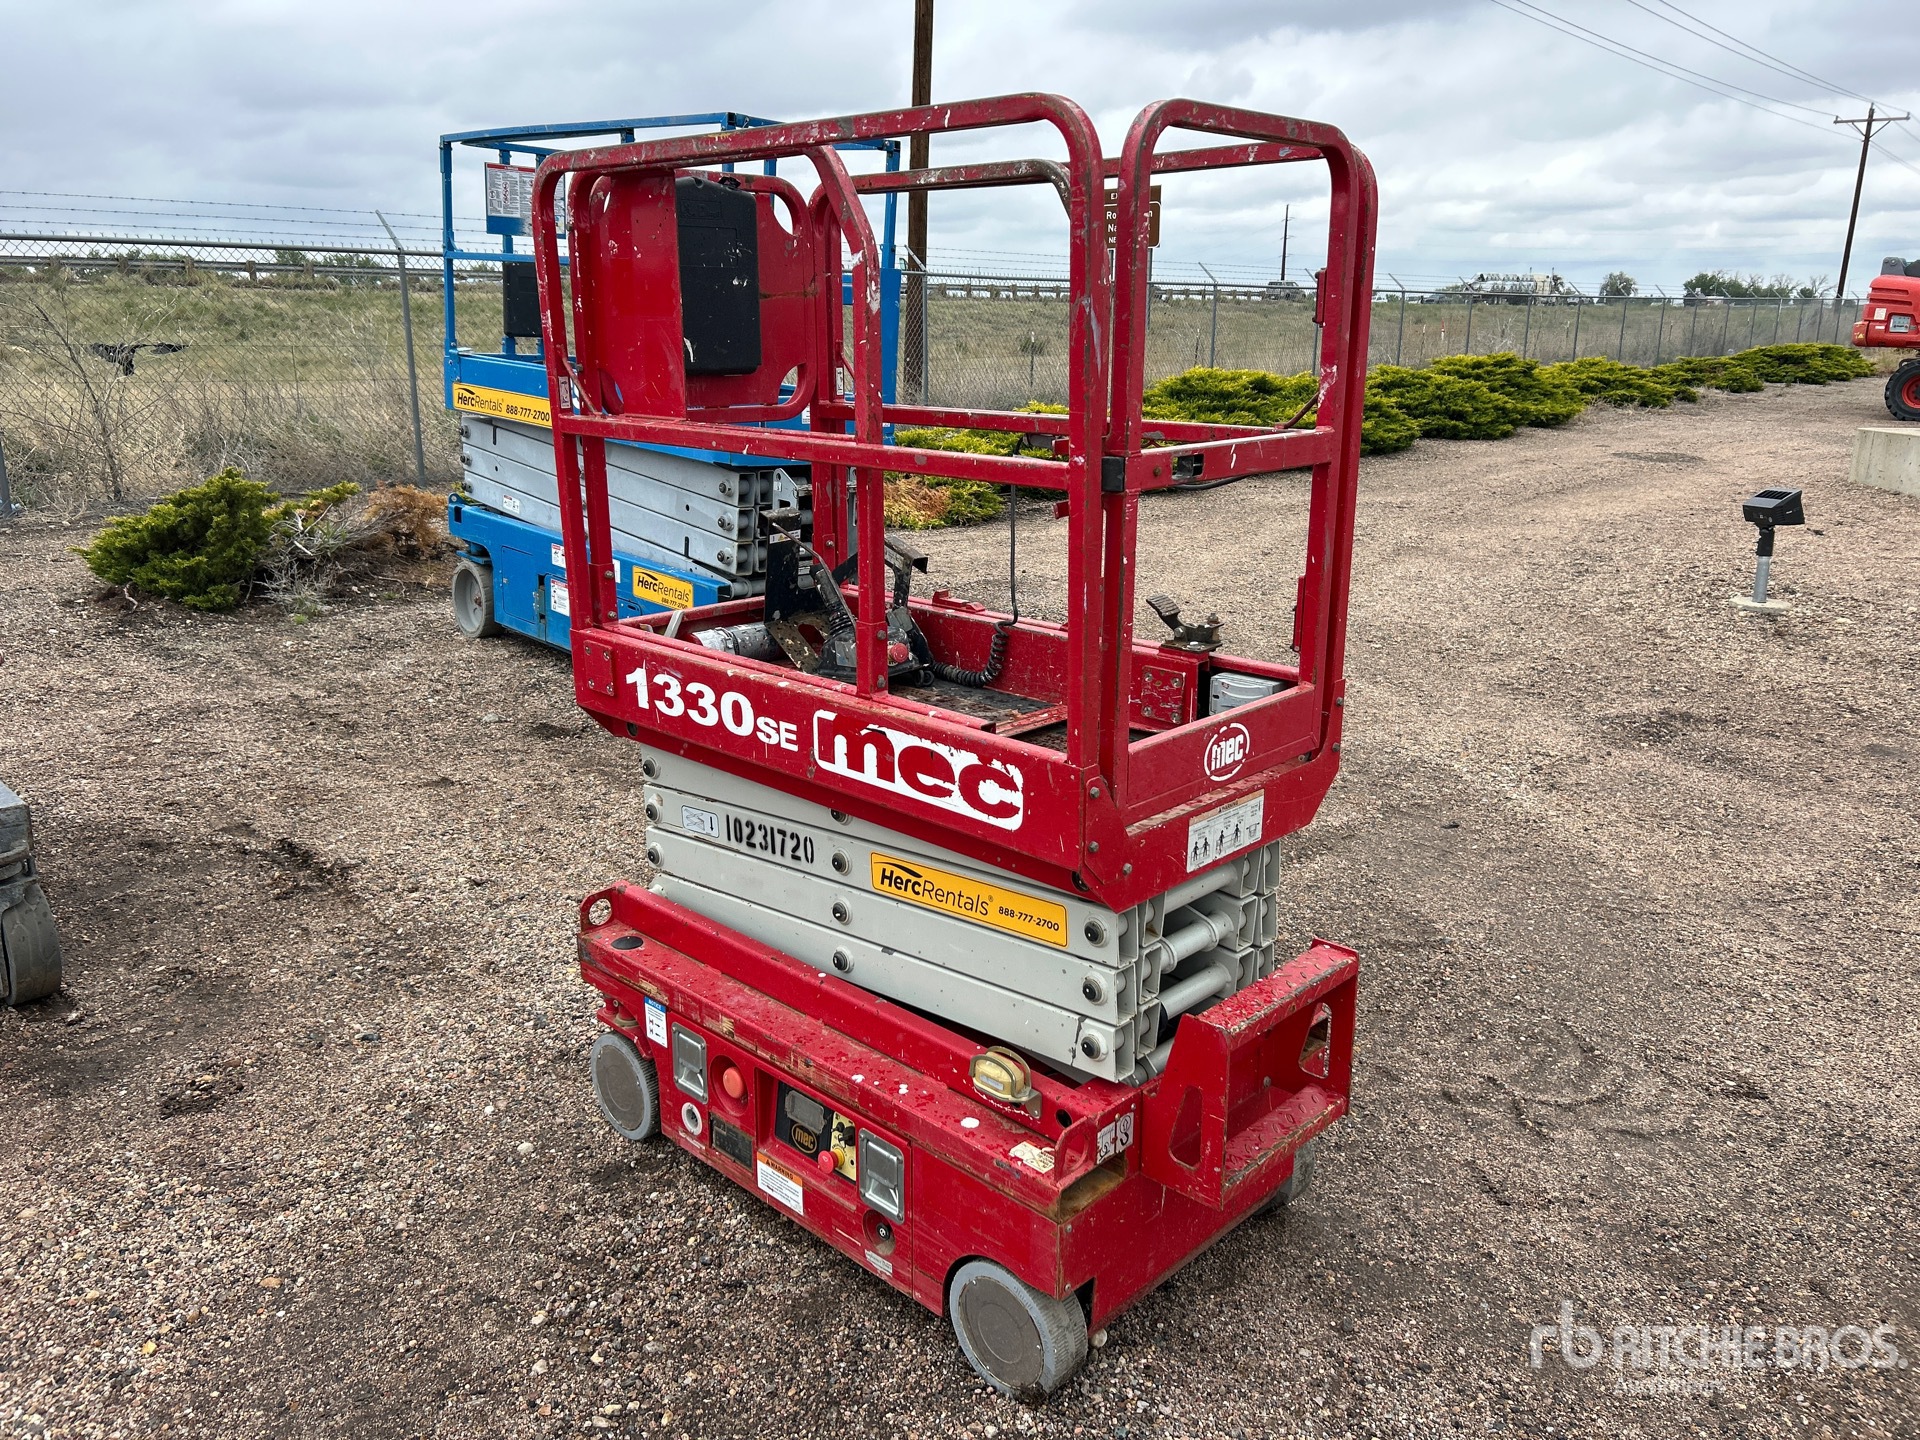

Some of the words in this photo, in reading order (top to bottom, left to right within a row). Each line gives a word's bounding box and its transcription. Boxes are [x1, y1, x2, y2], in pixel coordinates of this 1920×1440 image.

[457, 391, 503, 413] HercRentals
[505, 404, 550, 422] 888-777-2700
[637, 575, 690, 603] HercRentals
[726, 814, 815, 864] 10231720
[880, 867, 989, 917] HercRentals
[998, 906, 1060, 932] 888-777-2700
